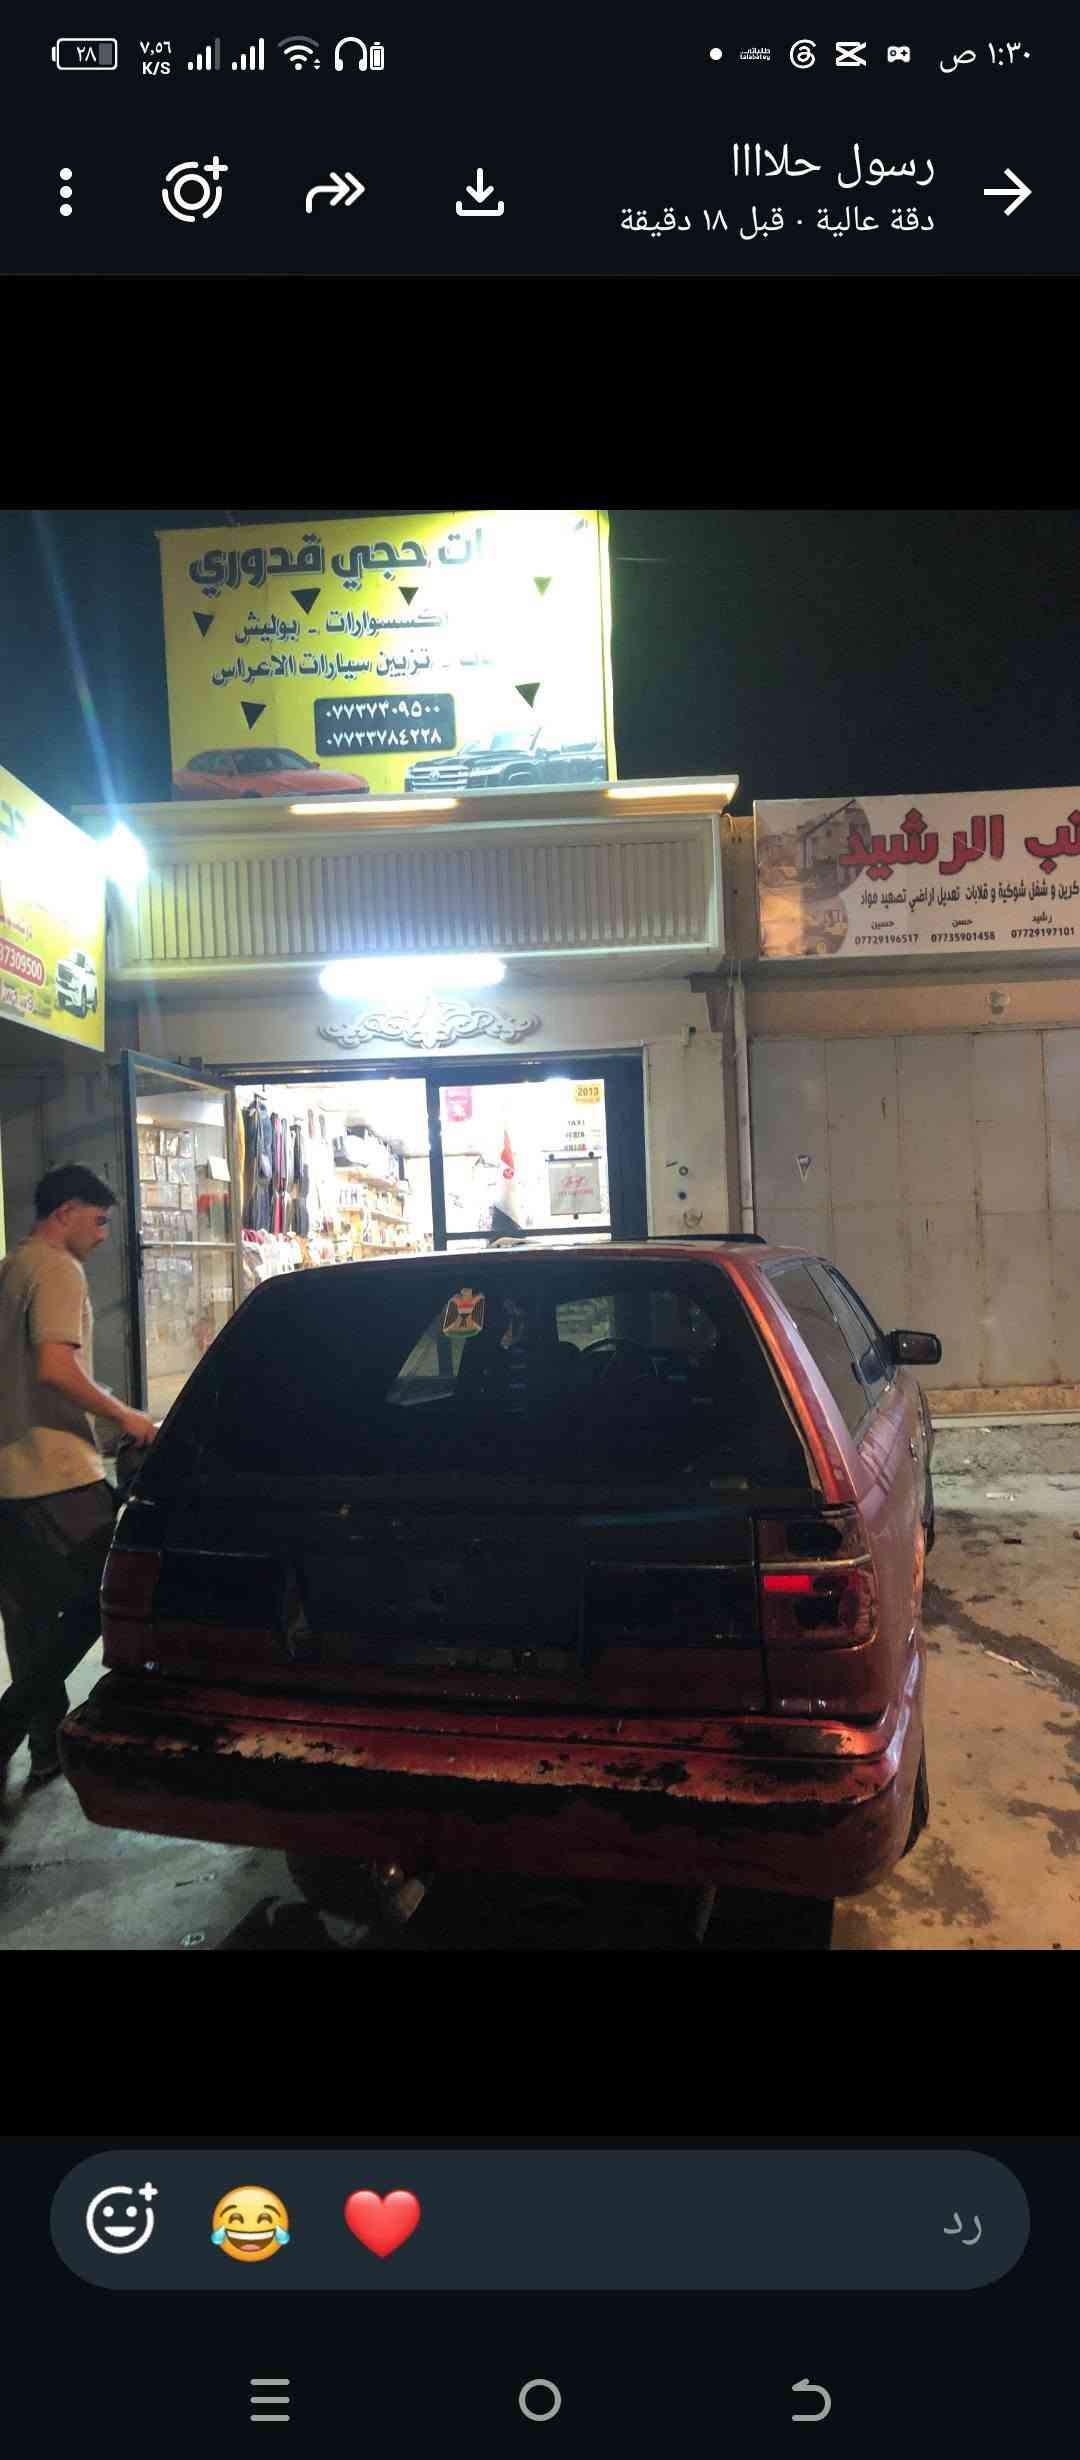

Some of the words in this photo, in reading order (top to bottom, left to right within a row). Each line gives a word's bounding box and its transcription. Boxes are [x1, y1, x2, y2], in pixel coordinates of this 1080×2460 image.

[189, 532, 326, 599] قدوري
[331, 540, 430, 591] حجي
[234, 610, 299, 644] بوليش
[211, 653, 297, 687] الاعراس
[300, 651, 371, 680] سيارات
[376, 648, 431, 678] تزيين
[839, 808, 1005, 881] الرشيد
